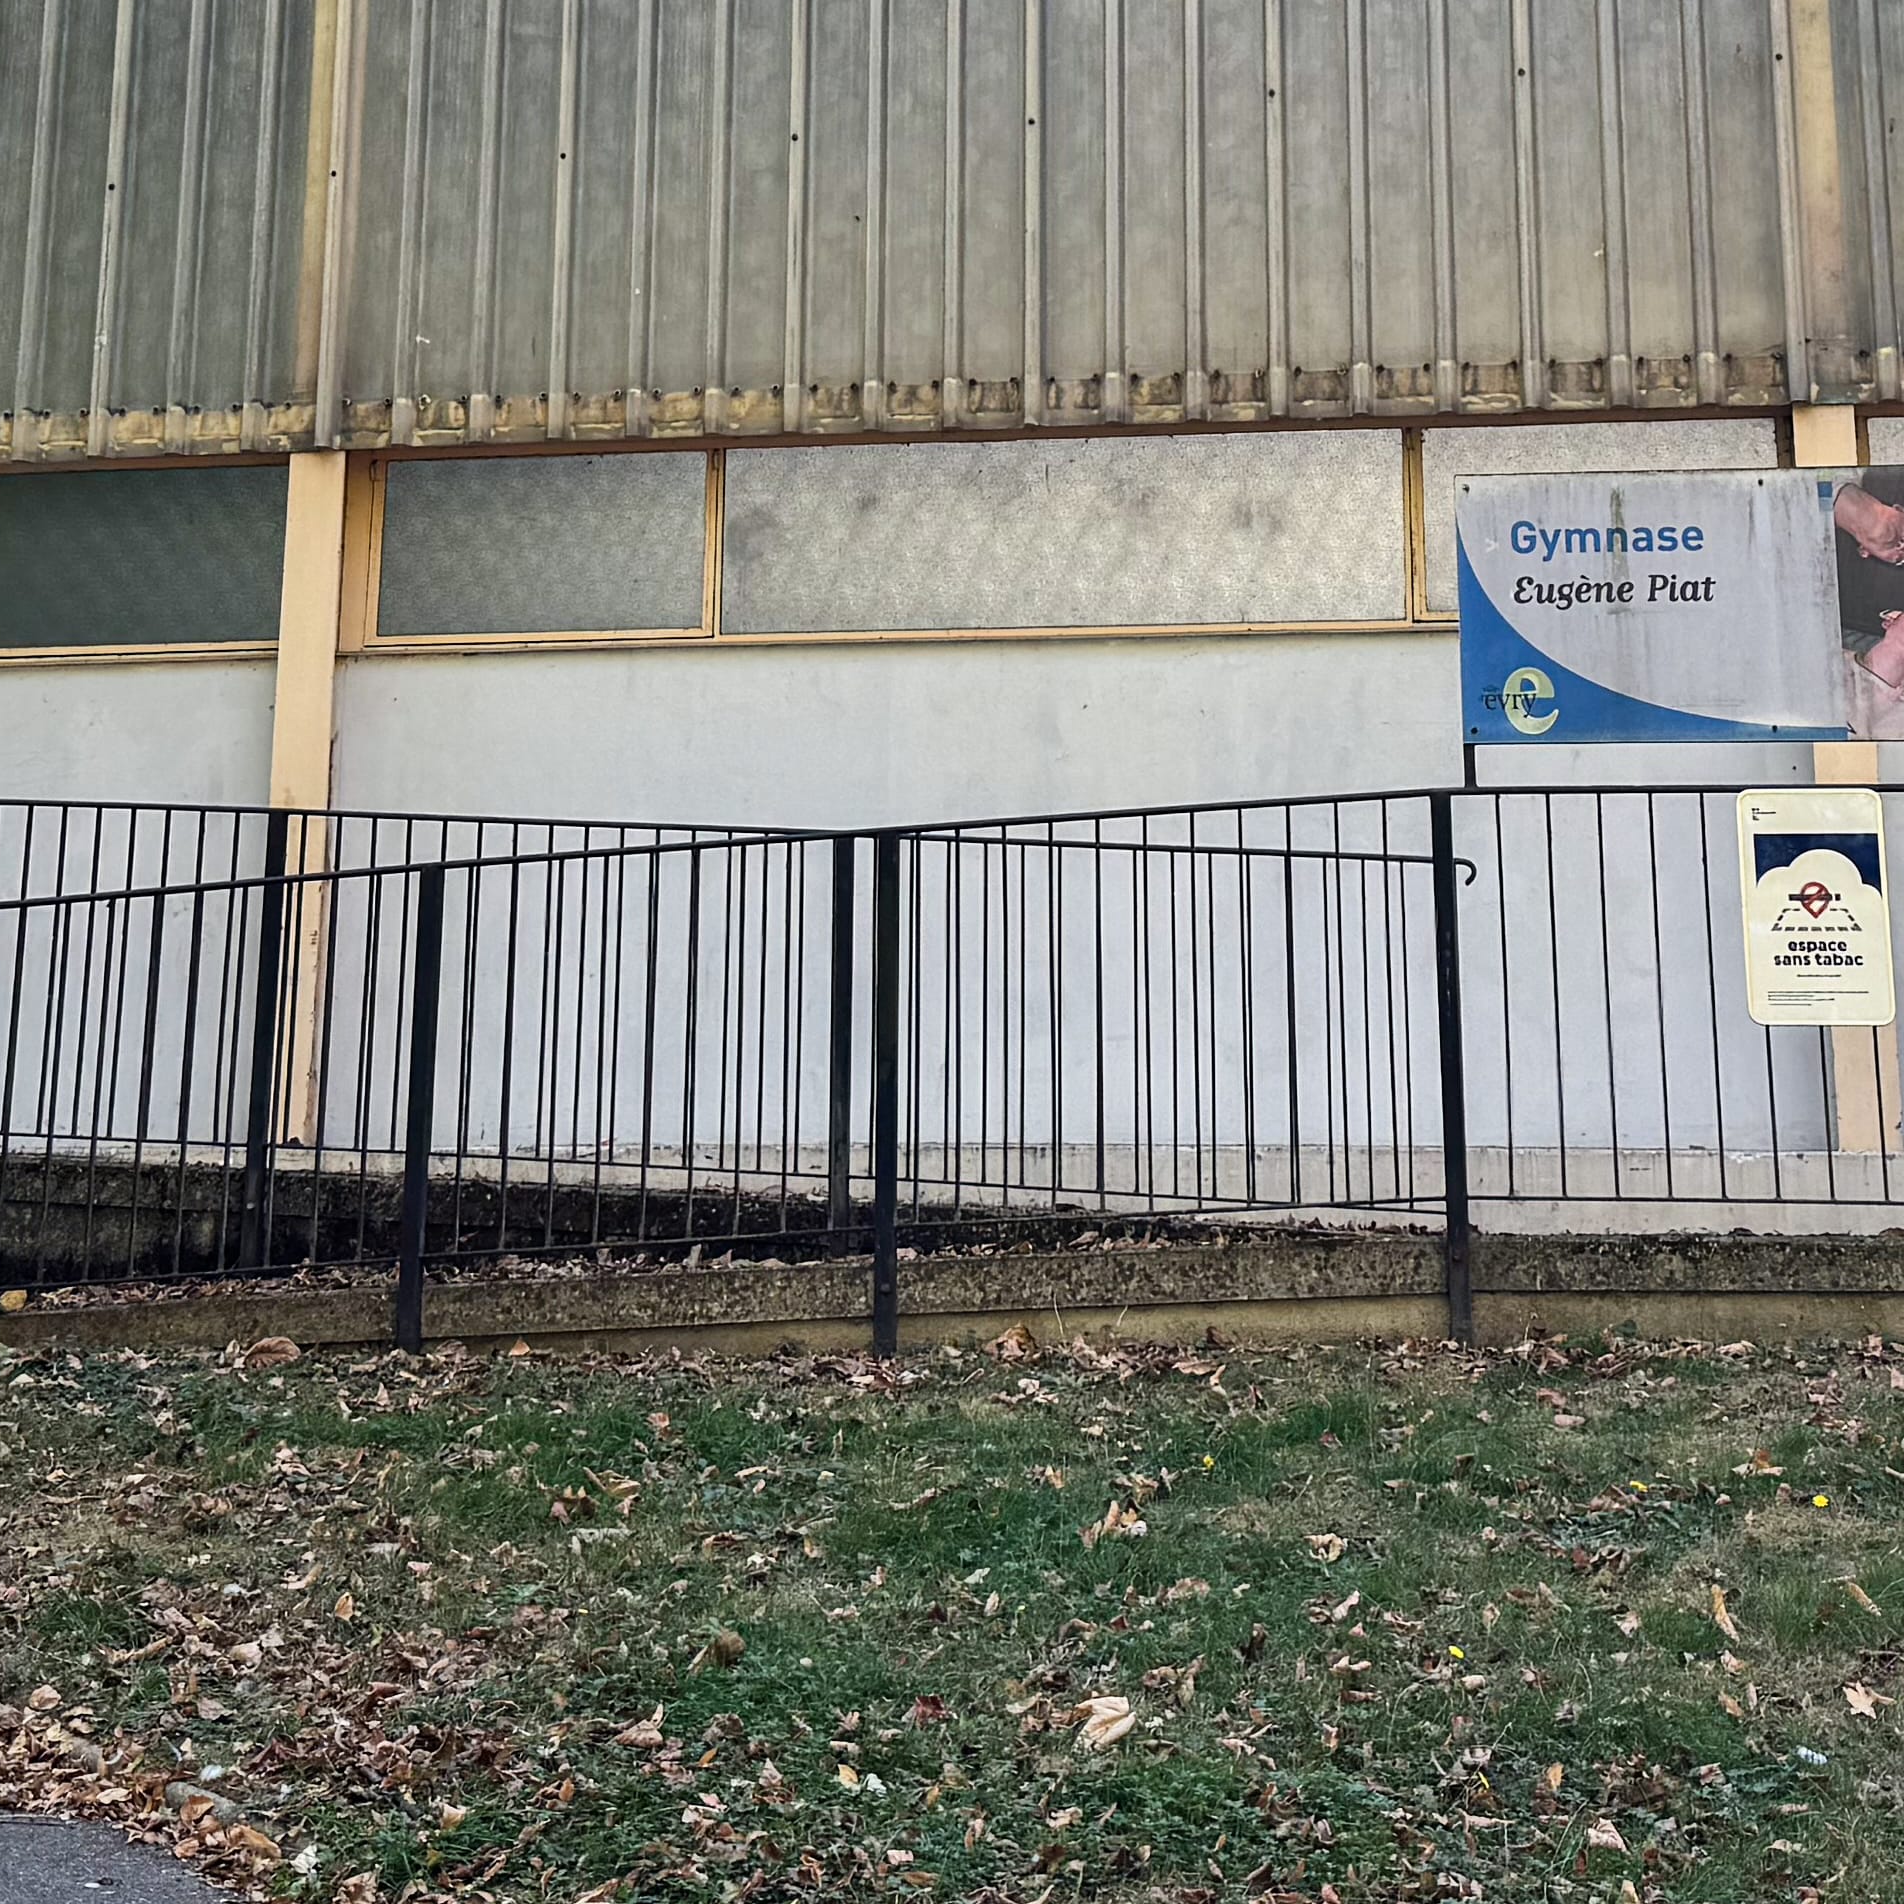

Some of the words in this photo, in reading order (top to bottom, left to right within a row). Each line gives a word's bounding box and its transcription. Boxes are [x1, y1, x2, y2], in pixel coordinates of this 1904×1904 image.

[1510, 520, 1704, 562] Gymnase
[1513, 574, 1634, 610] Eugène
[1647, 574, 1716, 602] Piat
[1787, 941, 1847, 953] espace
[1774, 955, 1811, 966] sans
[1814, 954, 1864, 966] tabac
